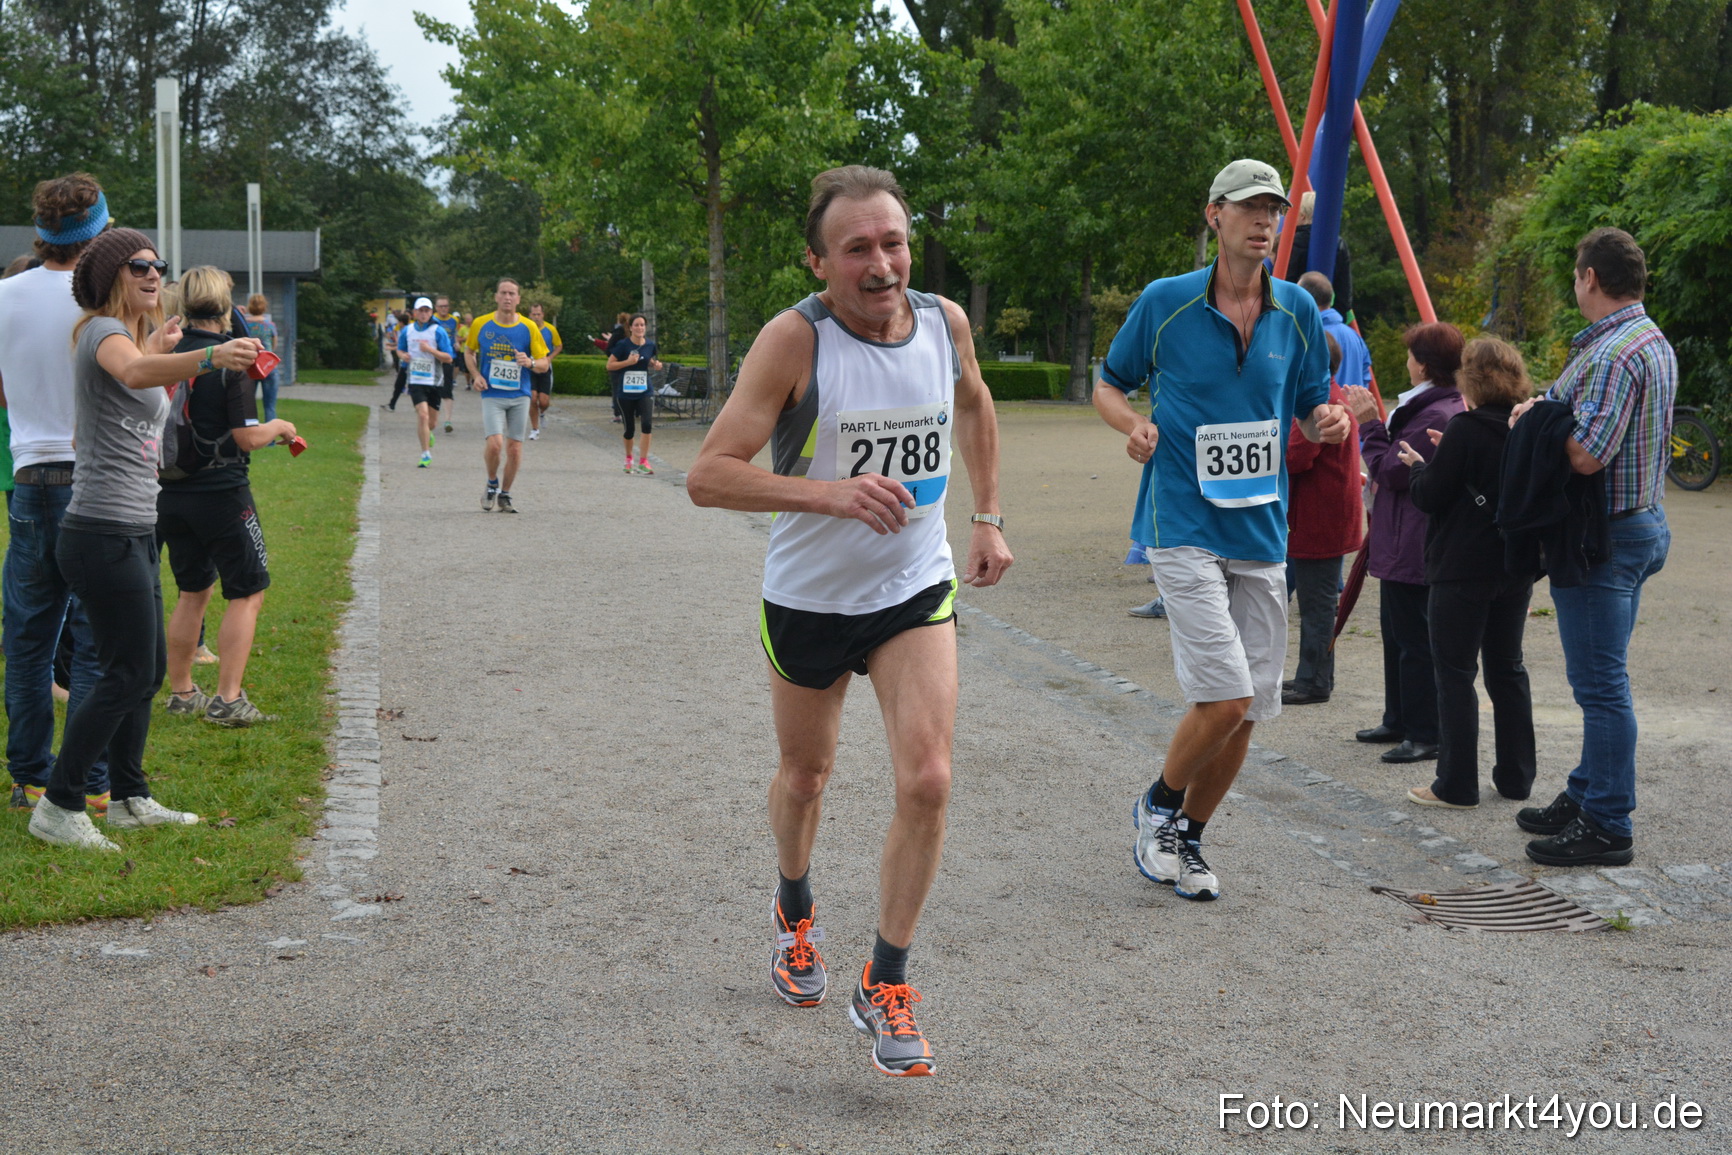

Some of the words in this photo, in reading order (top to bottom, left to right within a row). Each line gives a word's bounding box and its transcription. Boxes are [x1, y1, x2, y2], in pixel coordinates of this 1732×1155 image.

[493, 366, 518, 380] 2433
[626, 376, 645, 385] 2475
[840, 421, 881, 433] PARTL
[883, 416, 934, 431] Neumarkt
[1198, 432, 1229, 442] PARTL
[1230, 430, 1269, 440] Neumarkt
[850, 431, 941, 479] 2788
[1206, 441, 1272, 476] 3361
